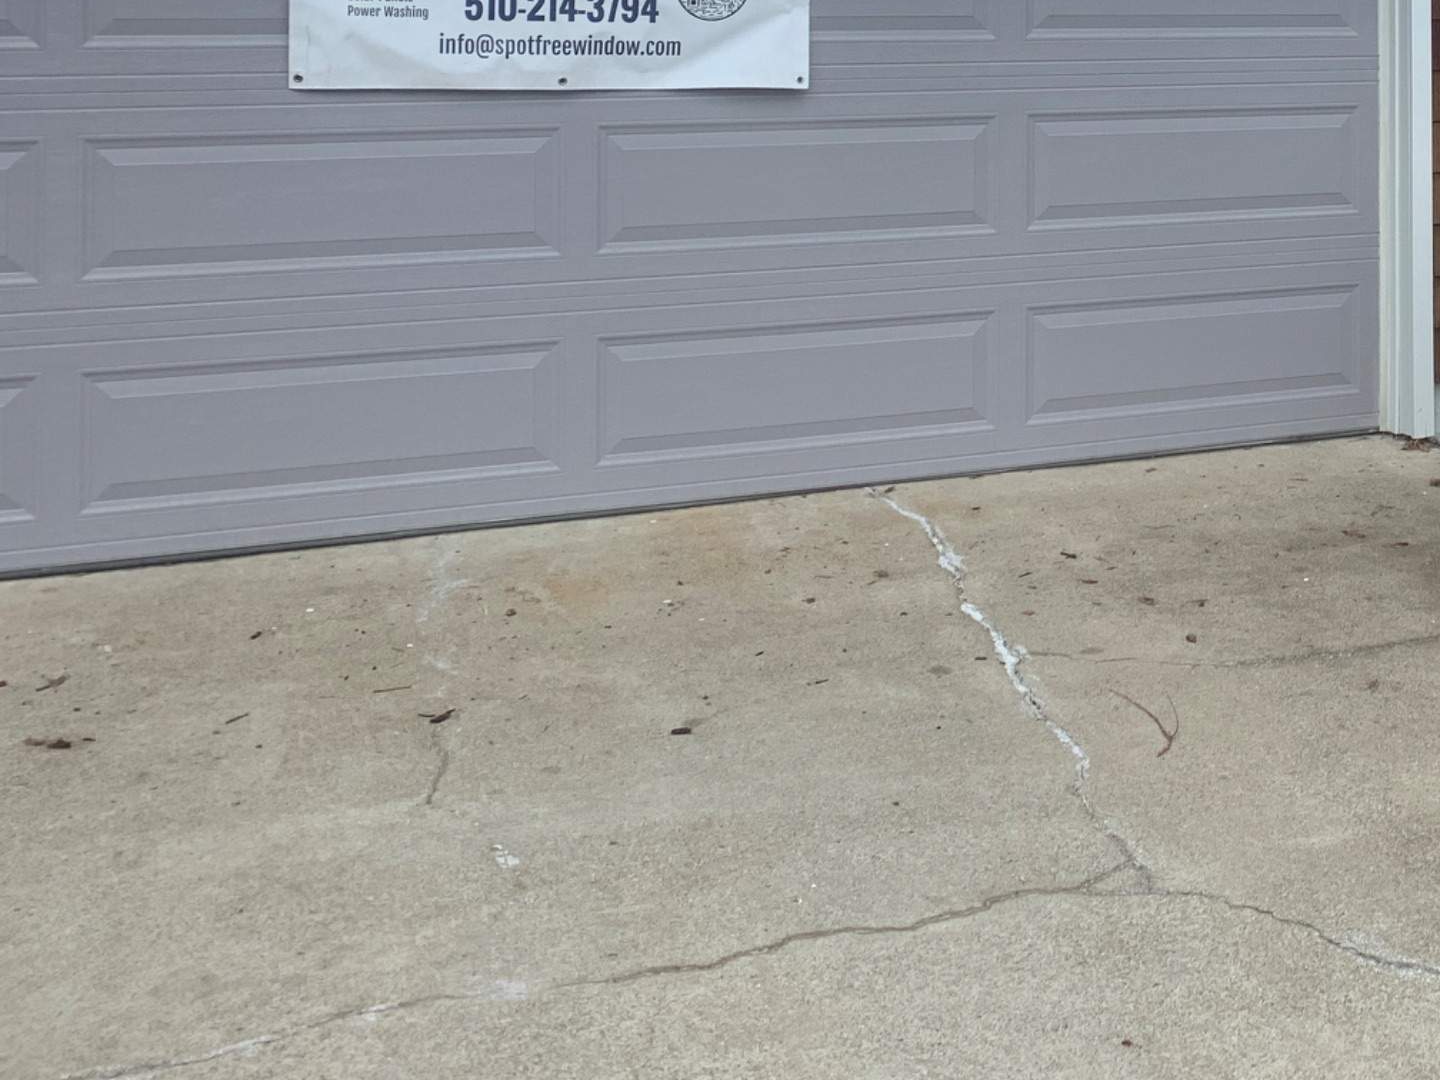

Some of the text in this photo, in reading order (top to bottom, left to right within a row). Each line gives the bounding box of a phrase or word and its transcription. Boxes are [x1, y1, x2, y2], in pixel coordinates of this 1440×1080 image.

[347, 5, 429, 20] Power Washing
[438, 32, 682, 59] info@spotfreewindow.com
